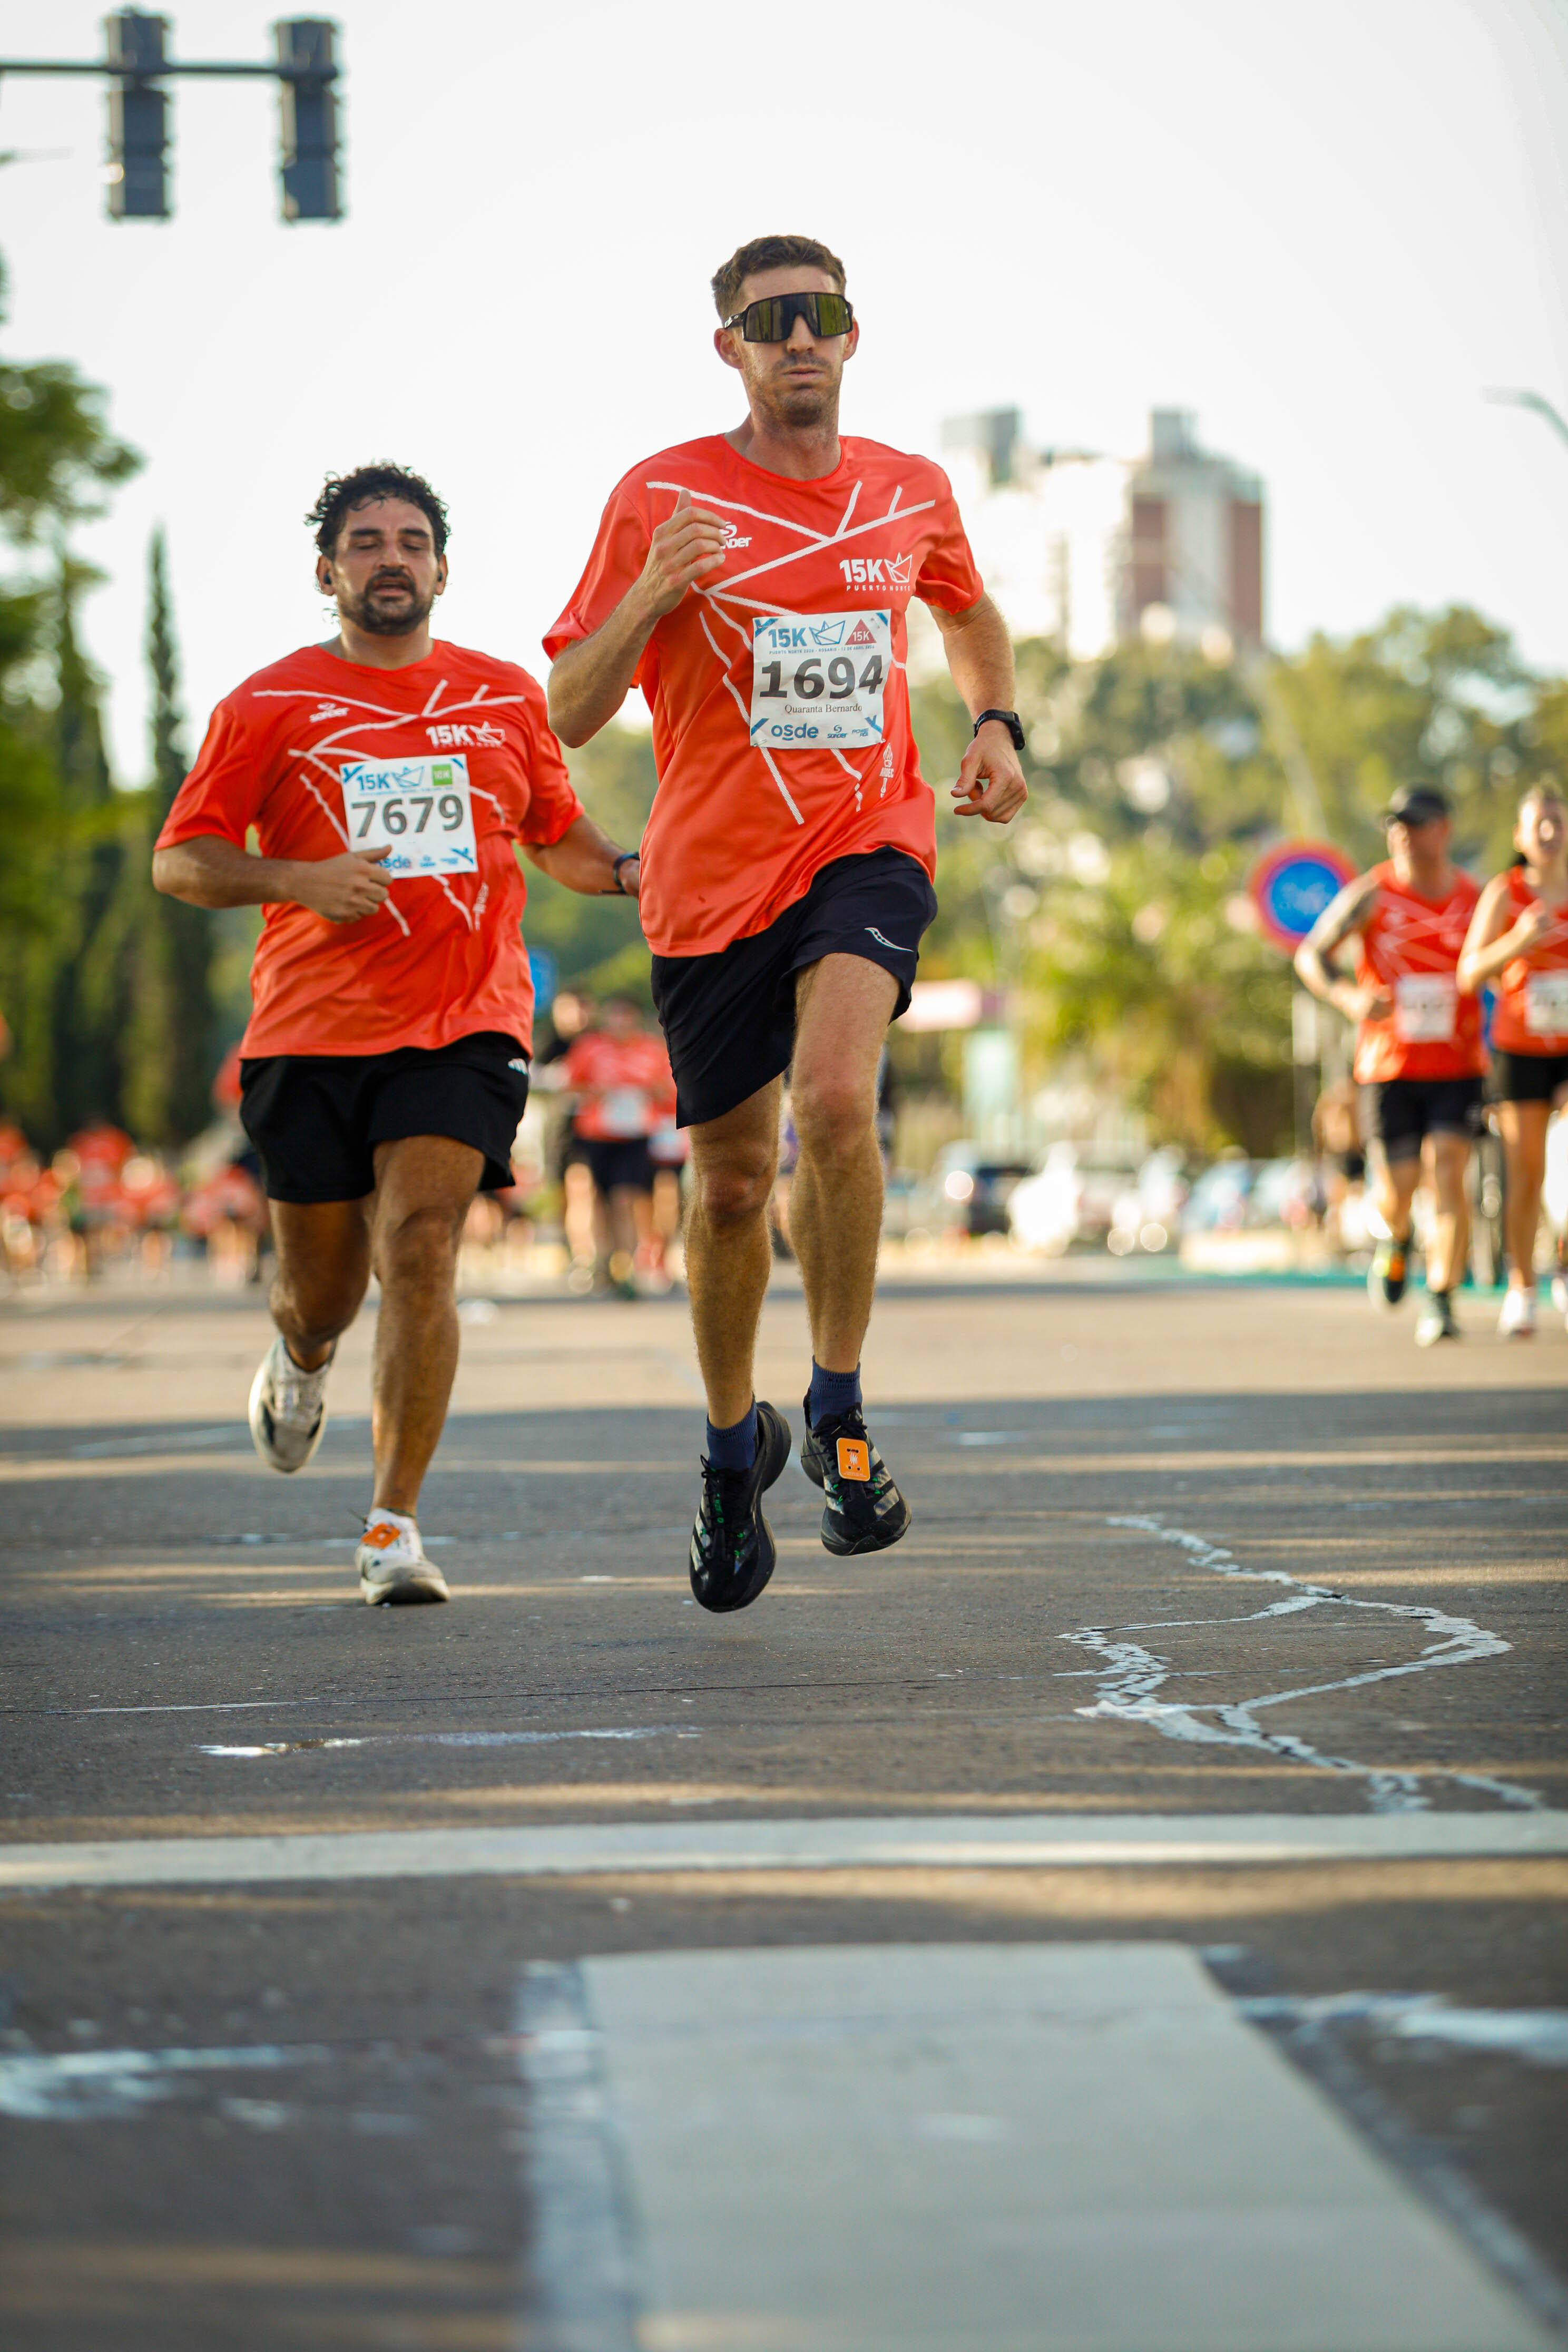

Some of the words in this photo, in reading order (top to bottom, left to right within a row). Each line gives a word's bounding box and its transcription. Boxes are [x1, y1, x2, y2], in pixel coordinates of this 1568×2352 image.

[839, 558, 886, 583] 15K
[768, 627, 807, 648] 15K
[852, 631, 869, 642] 15K
[759, 654, 883, 700] 1694
[785, 704, 822, 713] Quaranta
[826, 703, 863, 712] Bernardo
[425, 724, 474, 746] 15K
[771, 722, 819, 739] osde
[356, 772, 391, 790] 15K
[351, 794, 463, 838] 7679
